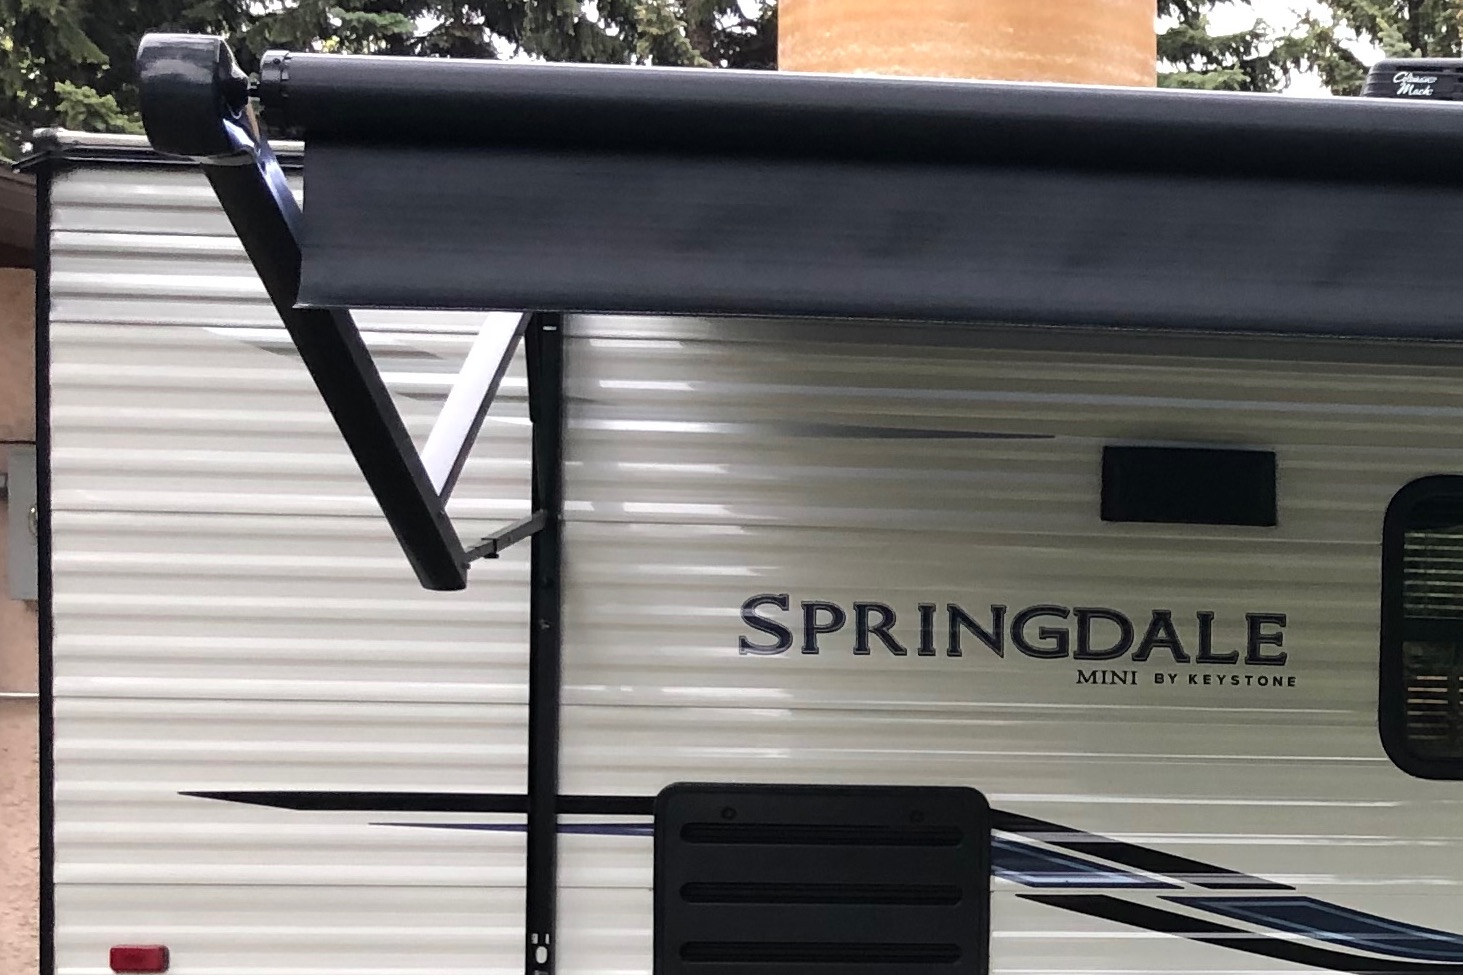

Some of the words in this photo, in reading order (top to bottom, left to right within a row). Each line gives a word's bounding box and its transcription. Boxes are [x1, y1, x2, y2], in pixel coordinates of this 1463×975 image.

[738, 593, 1288, 666] SPRINGDALE
[1076, 669, 1138, 685] MINI
[1154, 673, 1178, 685] BY
[1188, 673, 1297, 687] KEYSTONE
